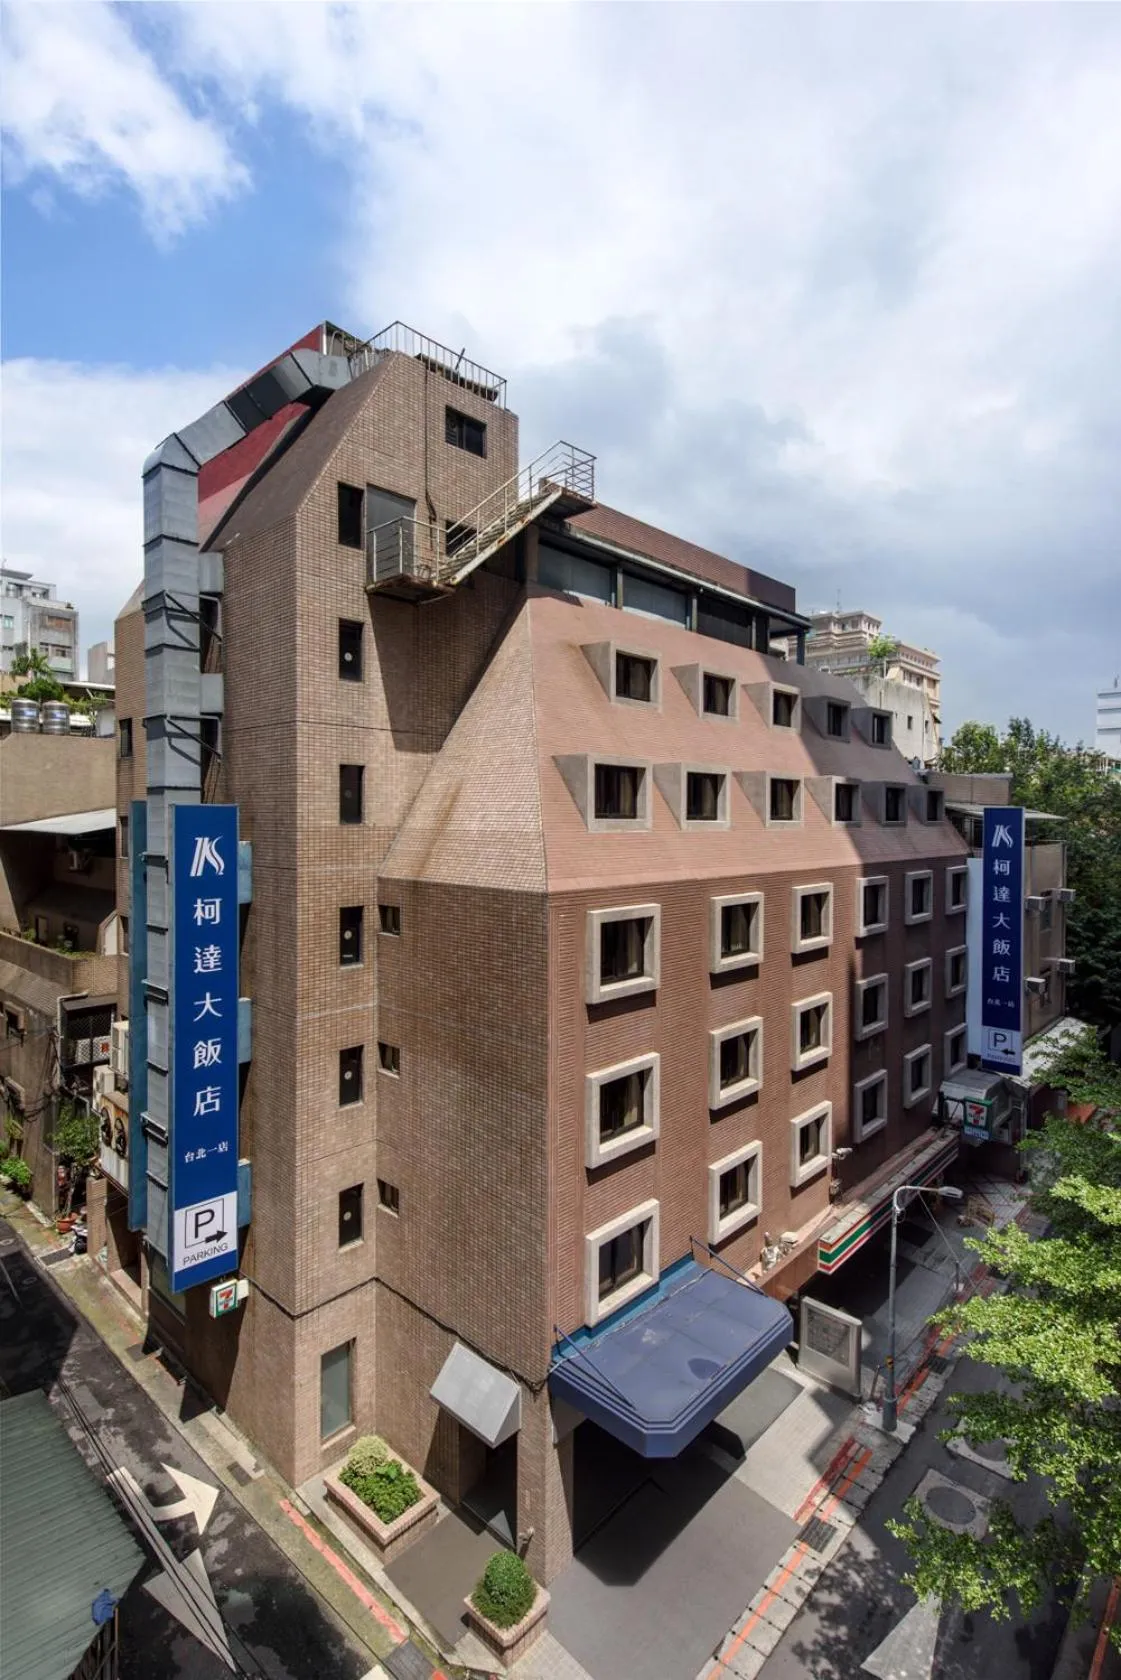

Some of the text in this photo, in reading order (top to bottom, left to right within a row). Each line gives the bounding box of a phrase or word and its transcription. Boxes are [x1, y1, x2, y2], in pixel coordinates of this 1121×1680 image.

[992, 858, 1011, 983] 柯達大飯店
[193, 897, 223, 1117] 柯達大飯店
[994, 1032, 1007, 1047] P
[184, 1141, 229, 1163] 台北一店
[194, 1208, 215, 1239] P
[183, 1242, 229, 1266] PARKING
